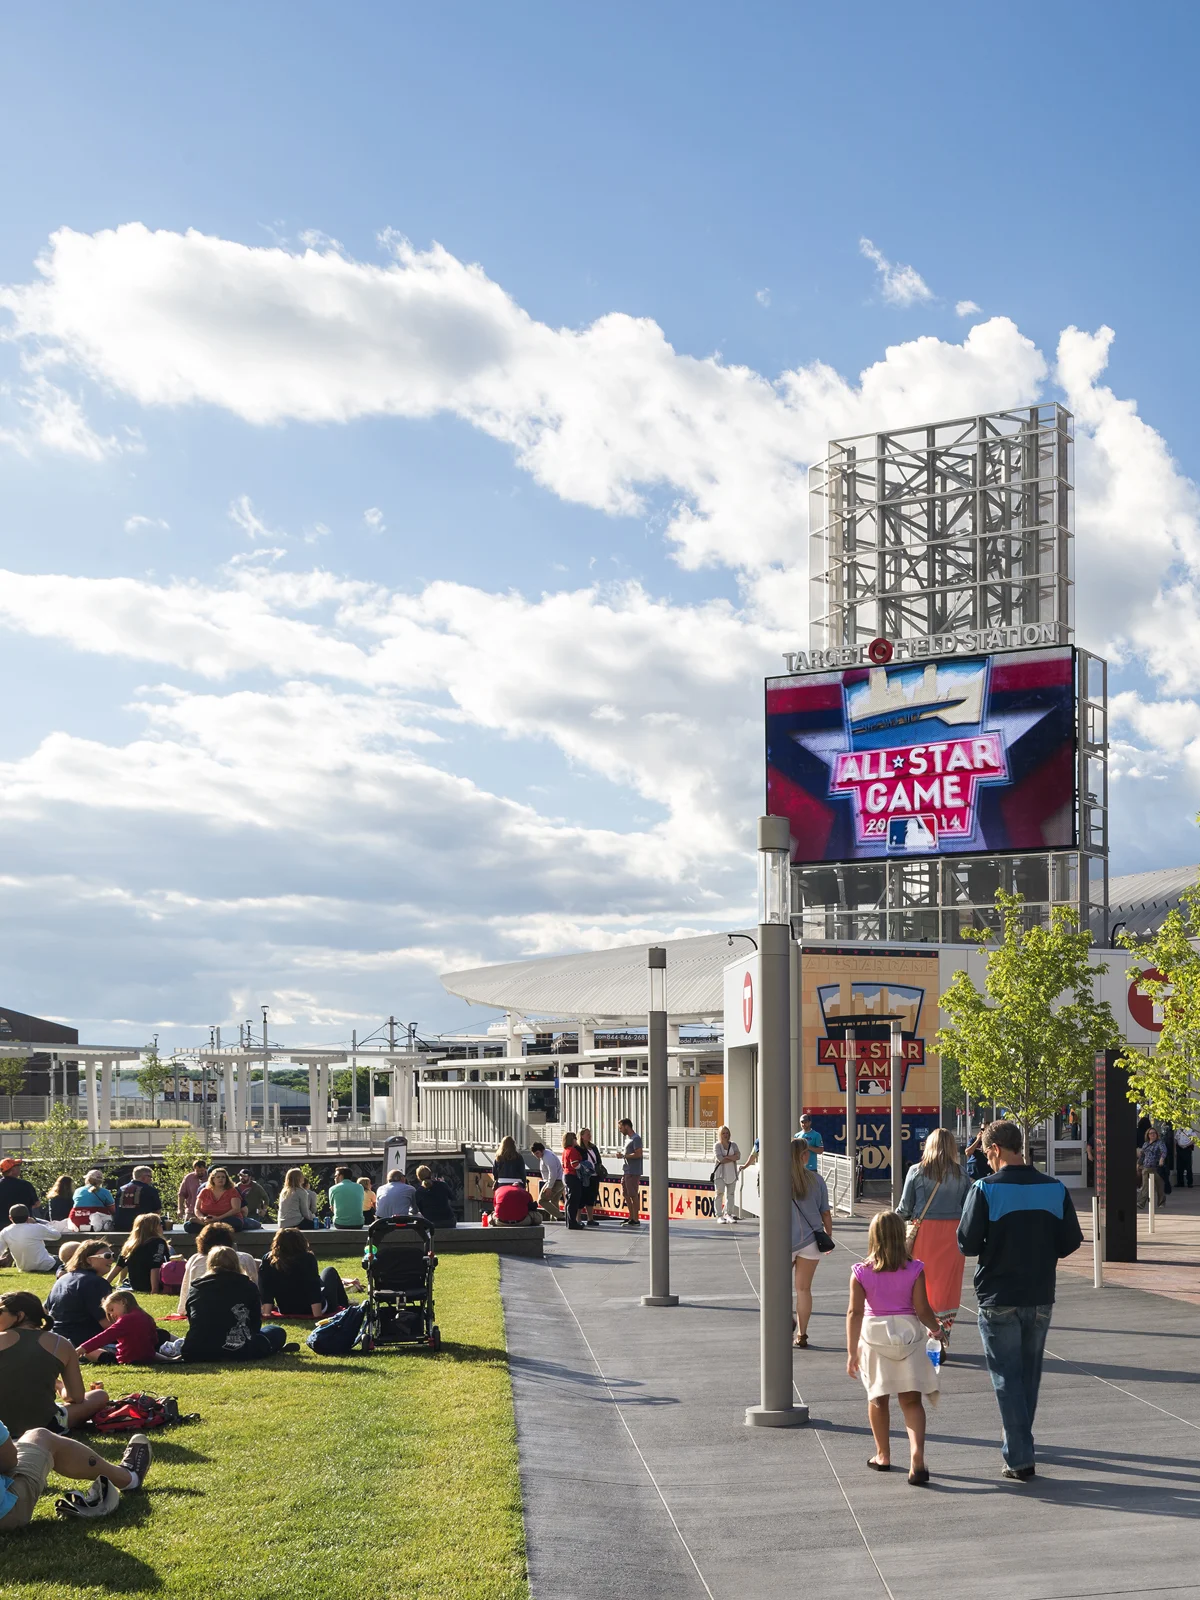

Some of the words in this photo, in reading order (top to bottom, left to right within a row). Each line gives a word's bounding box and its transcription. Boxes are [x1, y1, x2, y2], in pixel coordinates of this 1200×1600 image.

[783, 643, 865, 671] TARGET
[893, 633, 958, 658] FIELD
[964, 623, 1058, 651] STATION
[839, 752, 895, 782] ALL
[909, 740, 1000, 775] STAR
[866, 775, 966, 814] GAME
[842, 959, 882, 972] STAR
[888, 960, 936, 973] GAME
[824, 1043, 861, 1059] ALL
[614, 1188, 648, 1211] GAE
[695, 1196, 716, 1218] FOX
